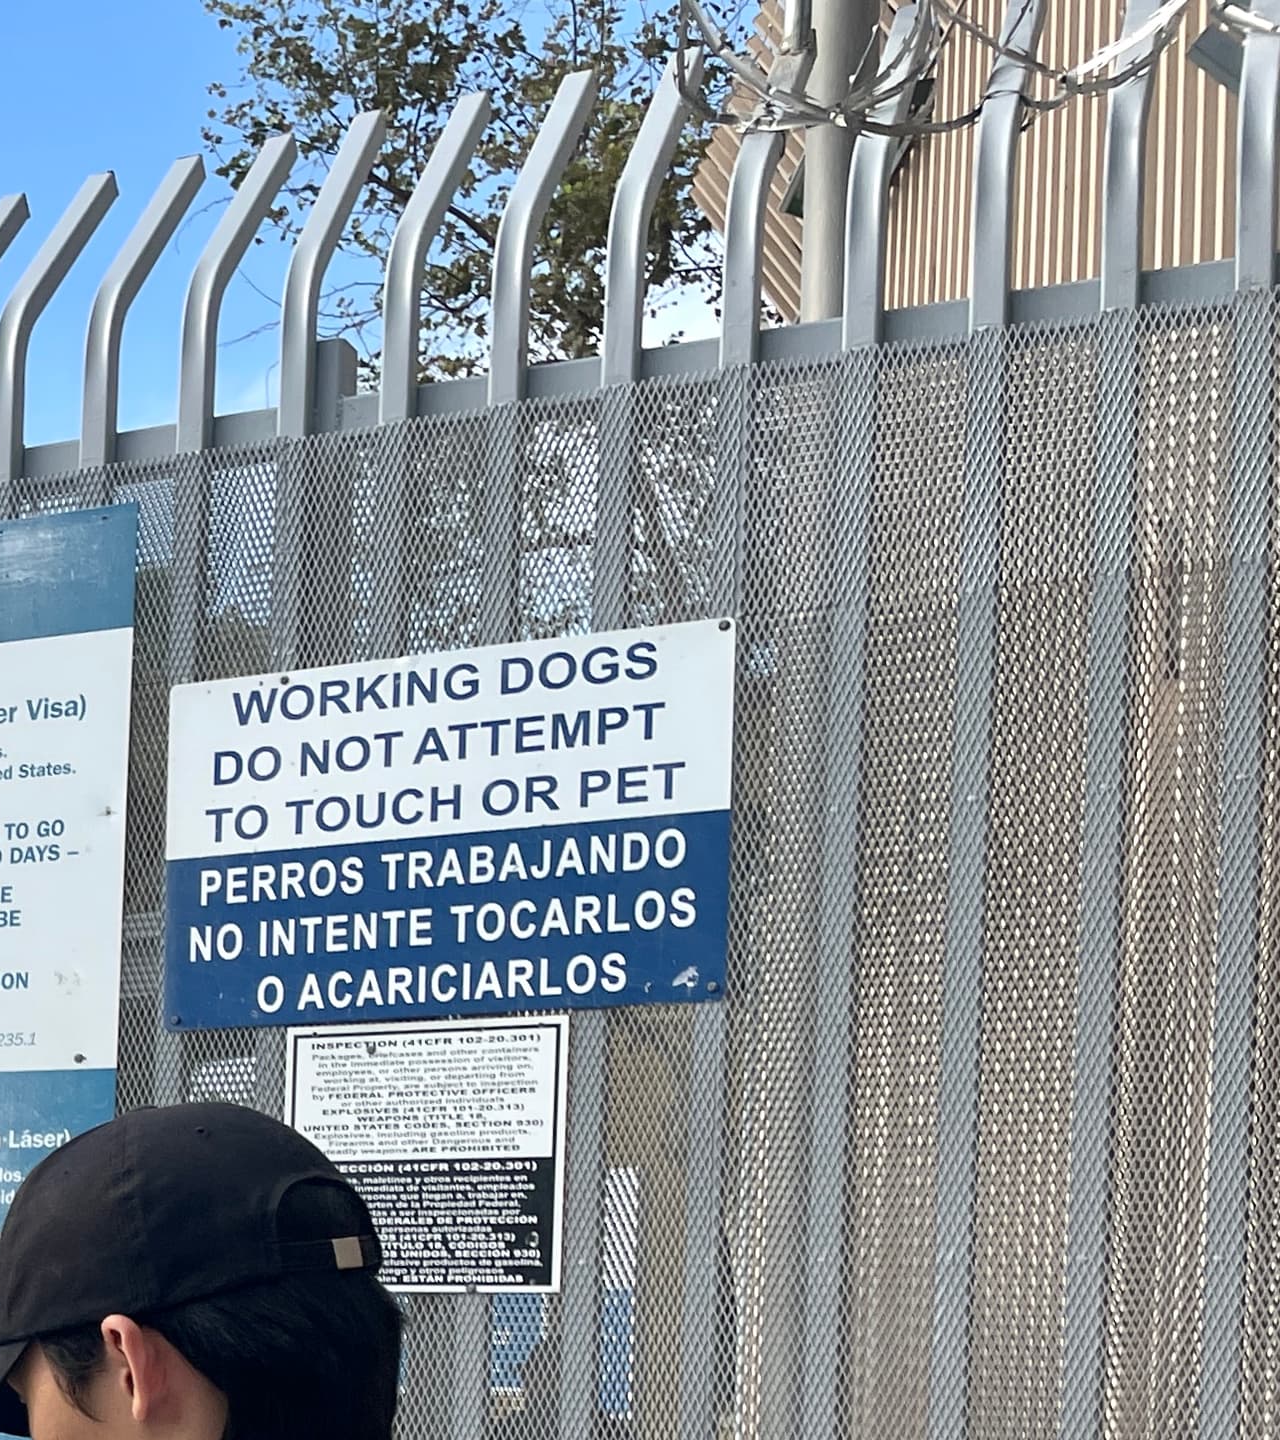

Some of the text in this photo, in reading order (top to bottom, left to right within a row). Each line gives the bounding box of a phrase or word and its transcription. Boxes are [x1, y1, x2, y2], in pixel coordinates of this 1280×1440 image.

[26, 694, 86, 720] Visa)
[232, 642, 657, 726] WORKING DOGS
[214, 702, 665, 785] DO NOT ATTEMPT
[205, 761, 685, 842] TO TOUCH OR PET
[200, 828, 685, 906] PERROS TRABAJANDO
[190, 888, 695, 962] NO INTENTE TOCARLOS
[257, 952, 626, 1012] O ACARICIARLOS
[8, 1129, 71, 1149] Láser)
